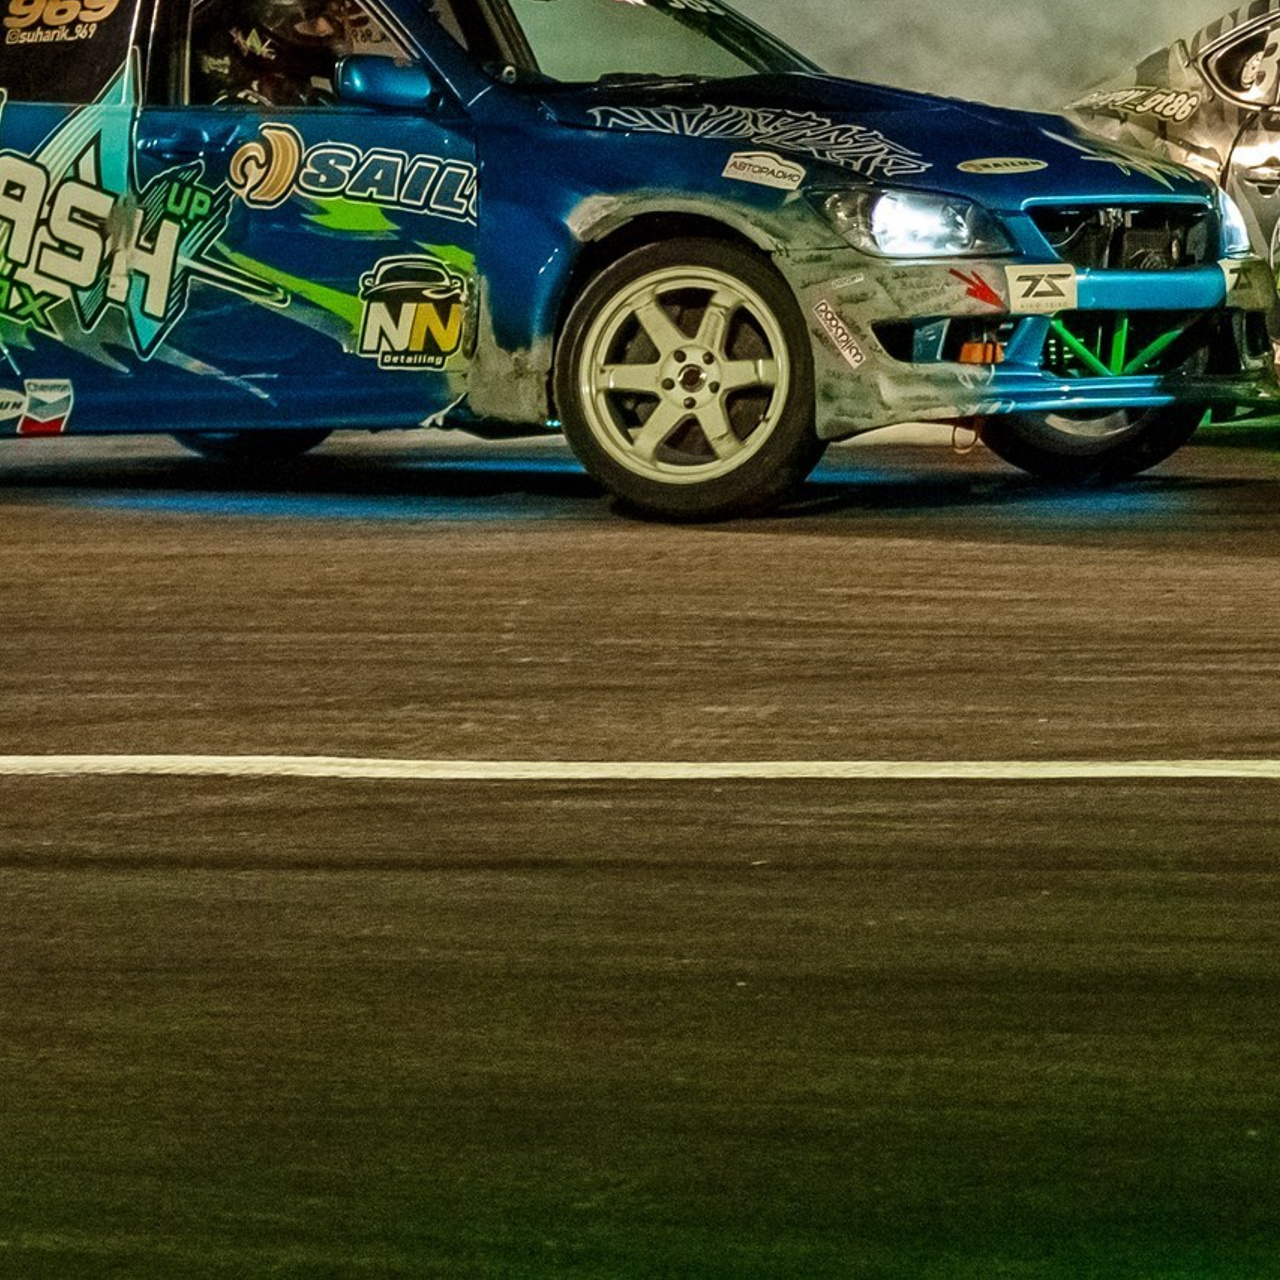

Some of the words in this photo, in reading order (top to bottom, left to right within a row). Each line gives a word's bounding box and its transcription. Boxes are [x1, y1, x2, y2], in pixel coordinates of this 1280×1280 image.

[5, 23, 98, 45] @suharik_969
[298, 147, 478, 222] SAIL
[729, 160, 801, 183] АВТОРАДИО
[166, 182, 212, 220] UP
[362, 302, 463, 352] NN
[382, 354, 444, 366] Detailing
